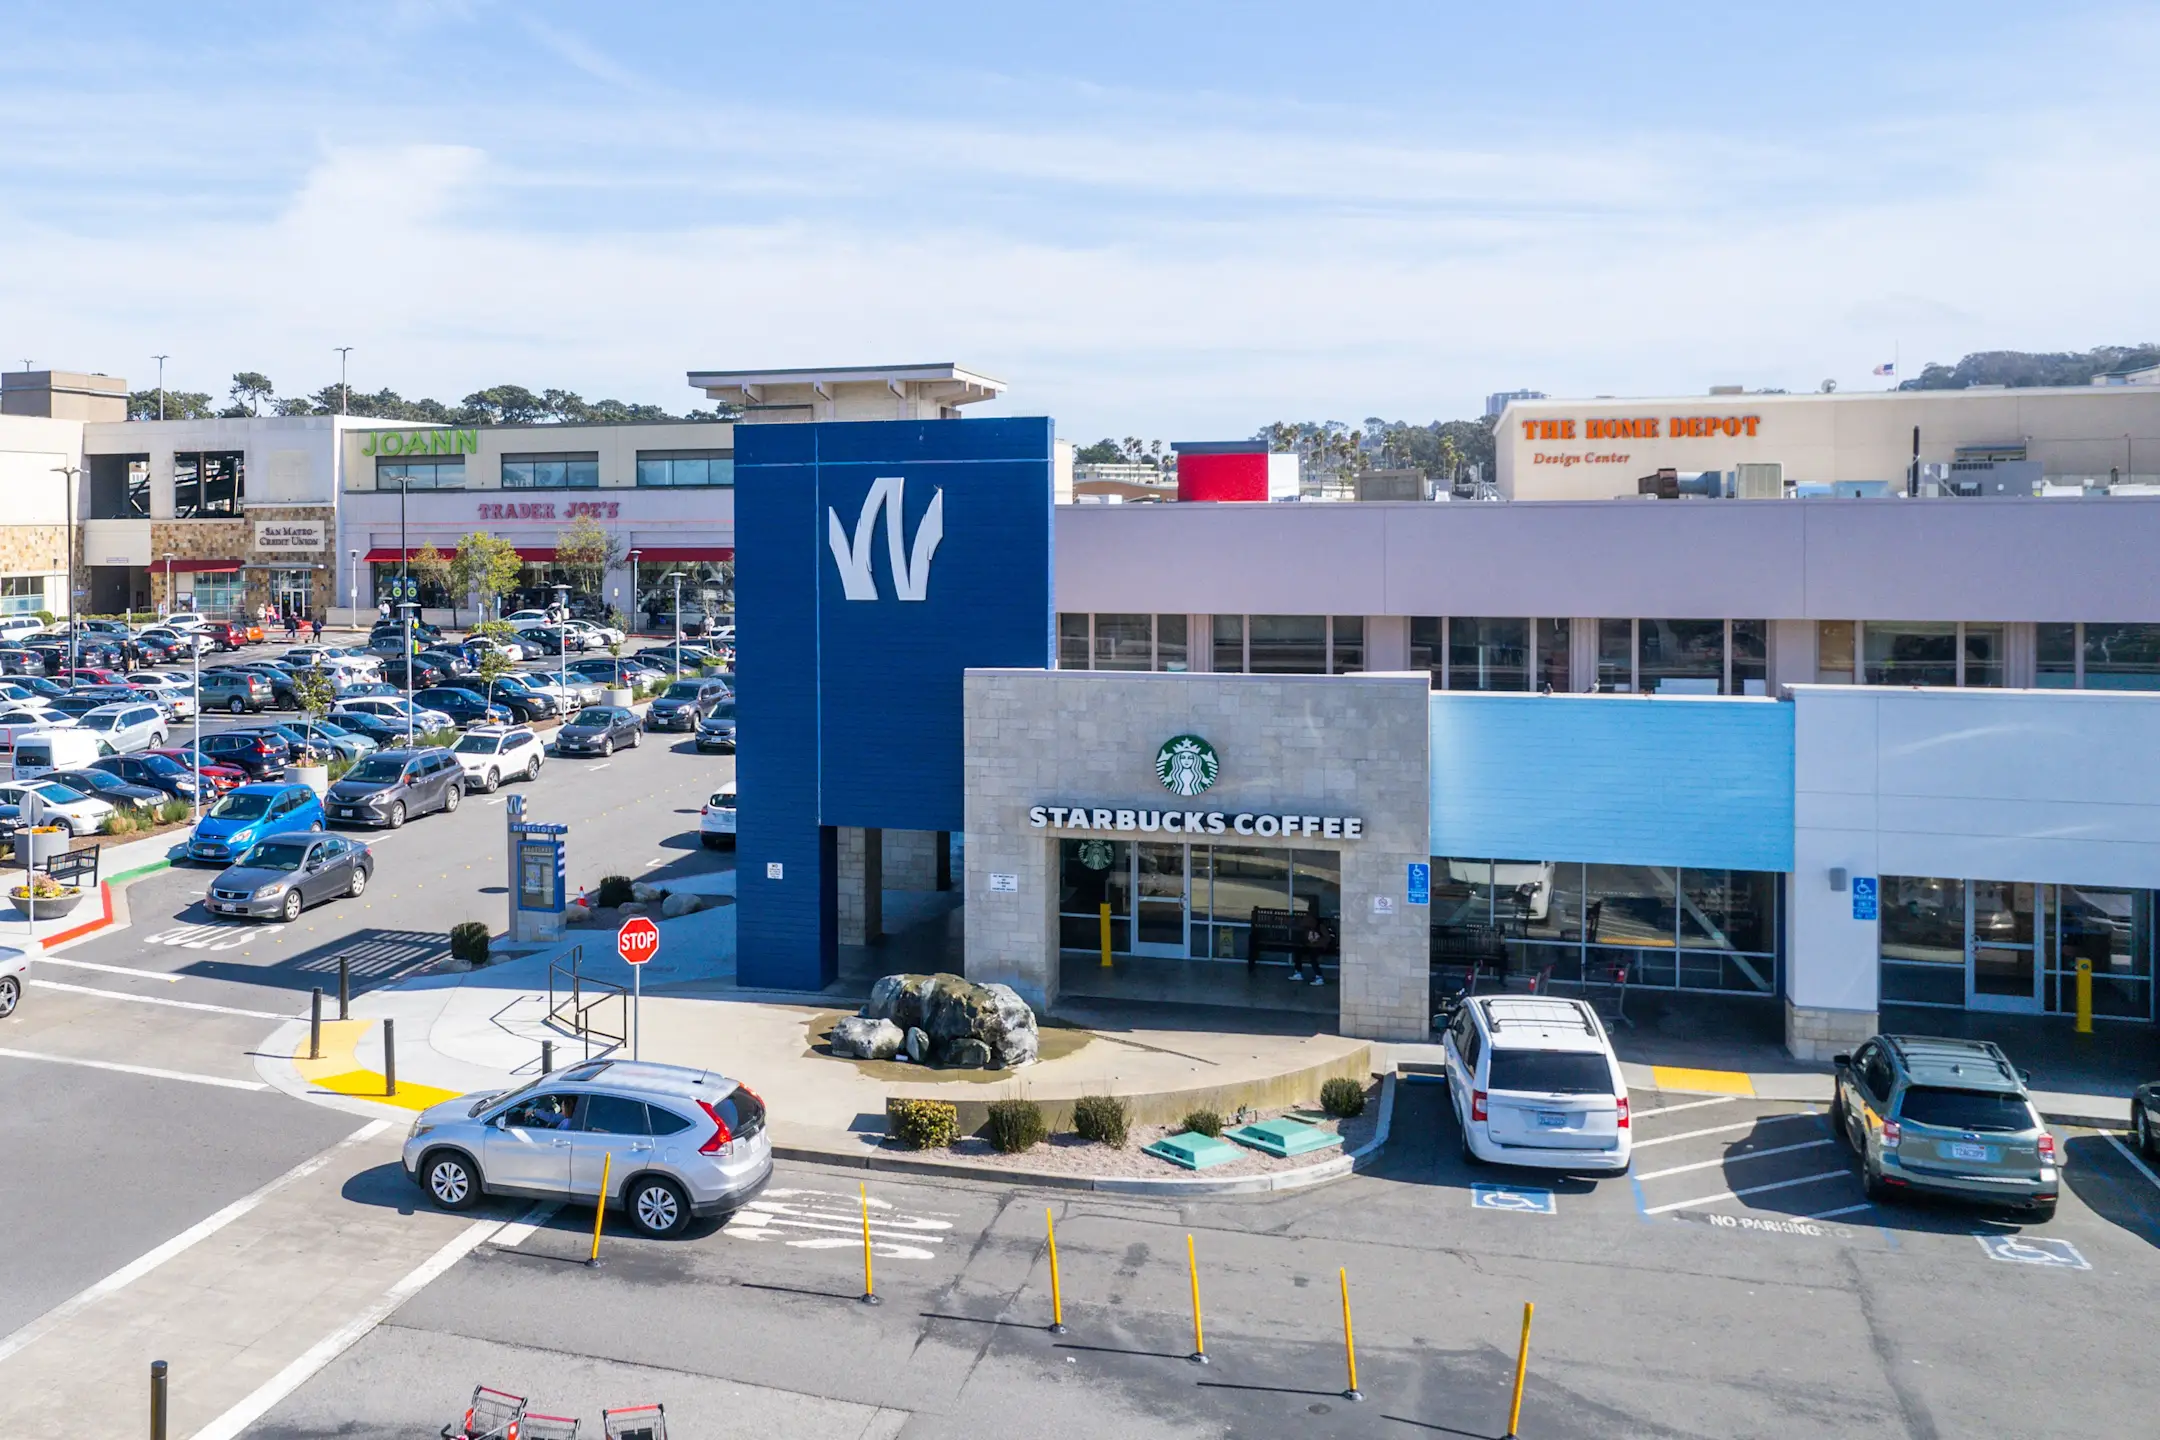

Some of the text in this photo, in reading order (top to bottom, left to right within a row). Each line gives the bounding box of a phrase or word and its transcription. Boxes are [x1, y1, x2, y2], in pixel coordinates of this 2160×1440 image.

[1522, 415, 1761, 440] THE HOME DEPOT
[361, 429, 477, 457] JOANN
[1533, 451, 1631, 467] Design Center
[478, 501, 621, 520] TRADER JOE'S
[513, 824, 558, 833] DIRECTORY
[1029, 806, 1363, 839] STARBUCKS COFFEE
[621, 931, 656, 951] STOP
[1709, 1214, 1736, 1227] NO
[1740, 1217, 1822, 1236] PARKING
